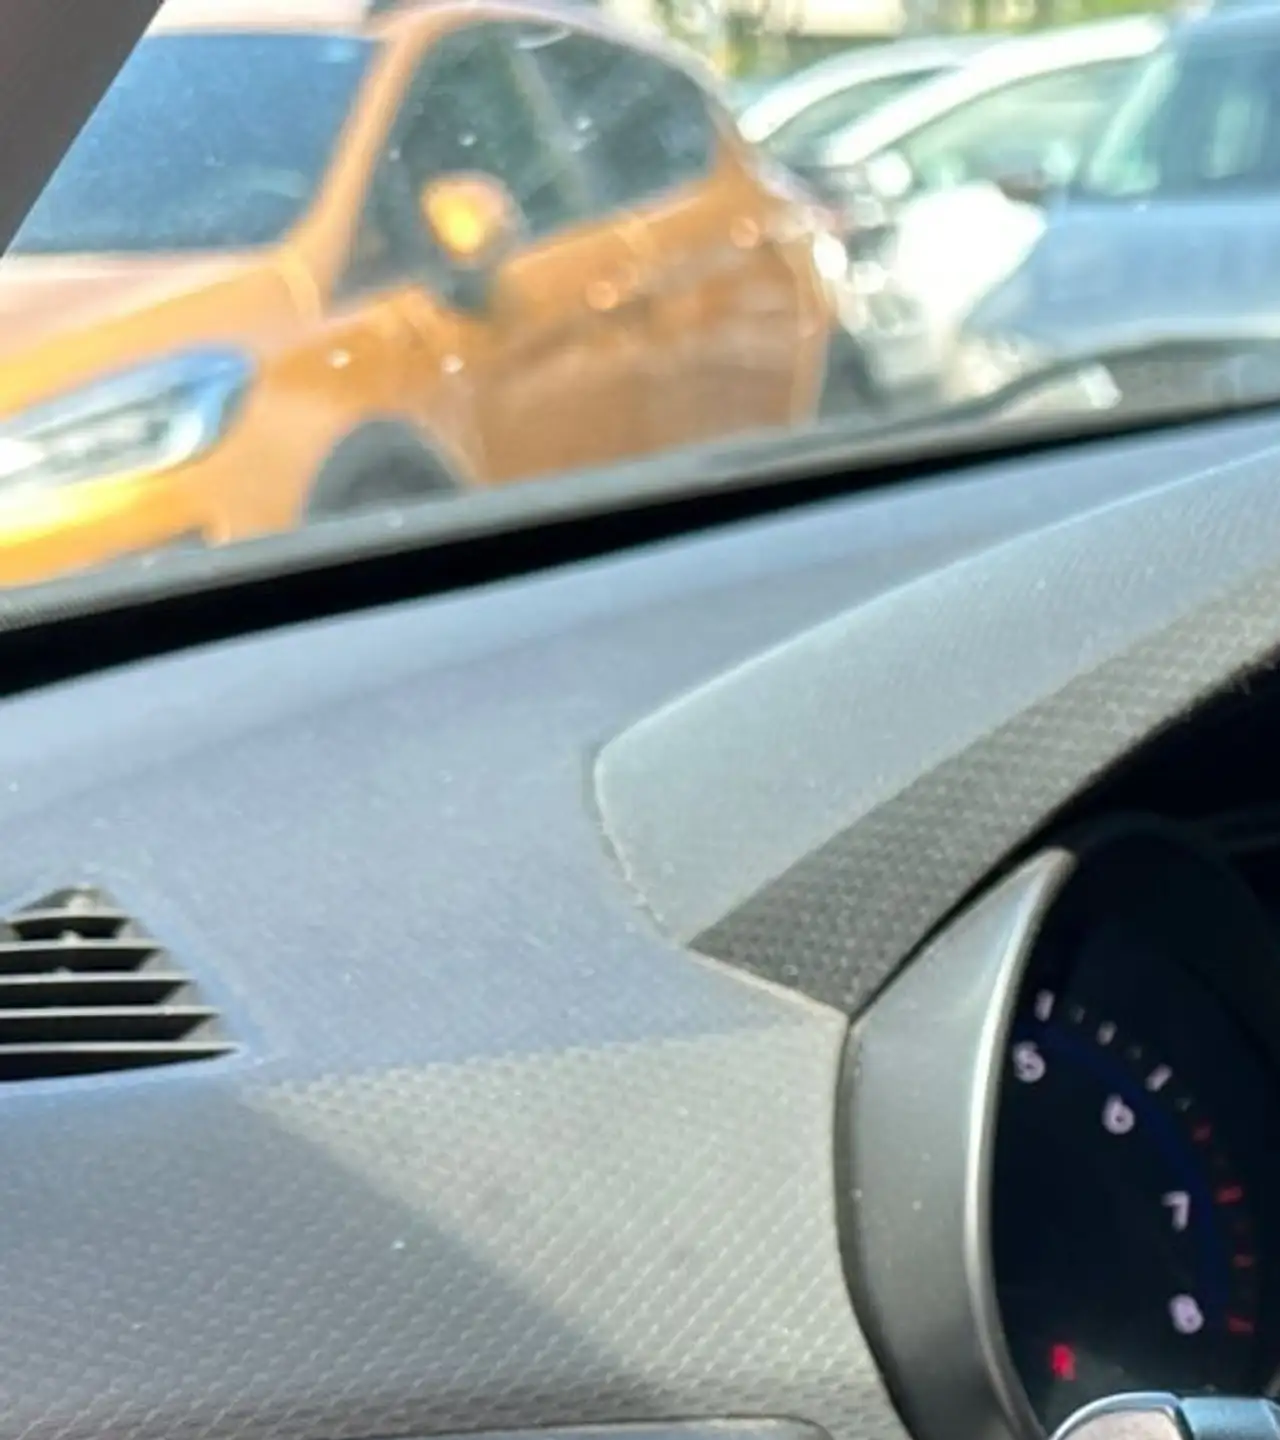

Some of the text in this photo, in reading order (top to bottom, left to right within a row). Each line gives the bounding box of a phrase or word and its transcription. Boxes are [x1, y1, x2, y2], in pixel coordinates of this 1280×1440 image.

[1013, 1040, 1046, 1083] 5
[1102, 1094, 1135, 1135] 6
[1163, 1191, 1191, 1231] 7
[1169, 1293, 1204, 1335] 8
